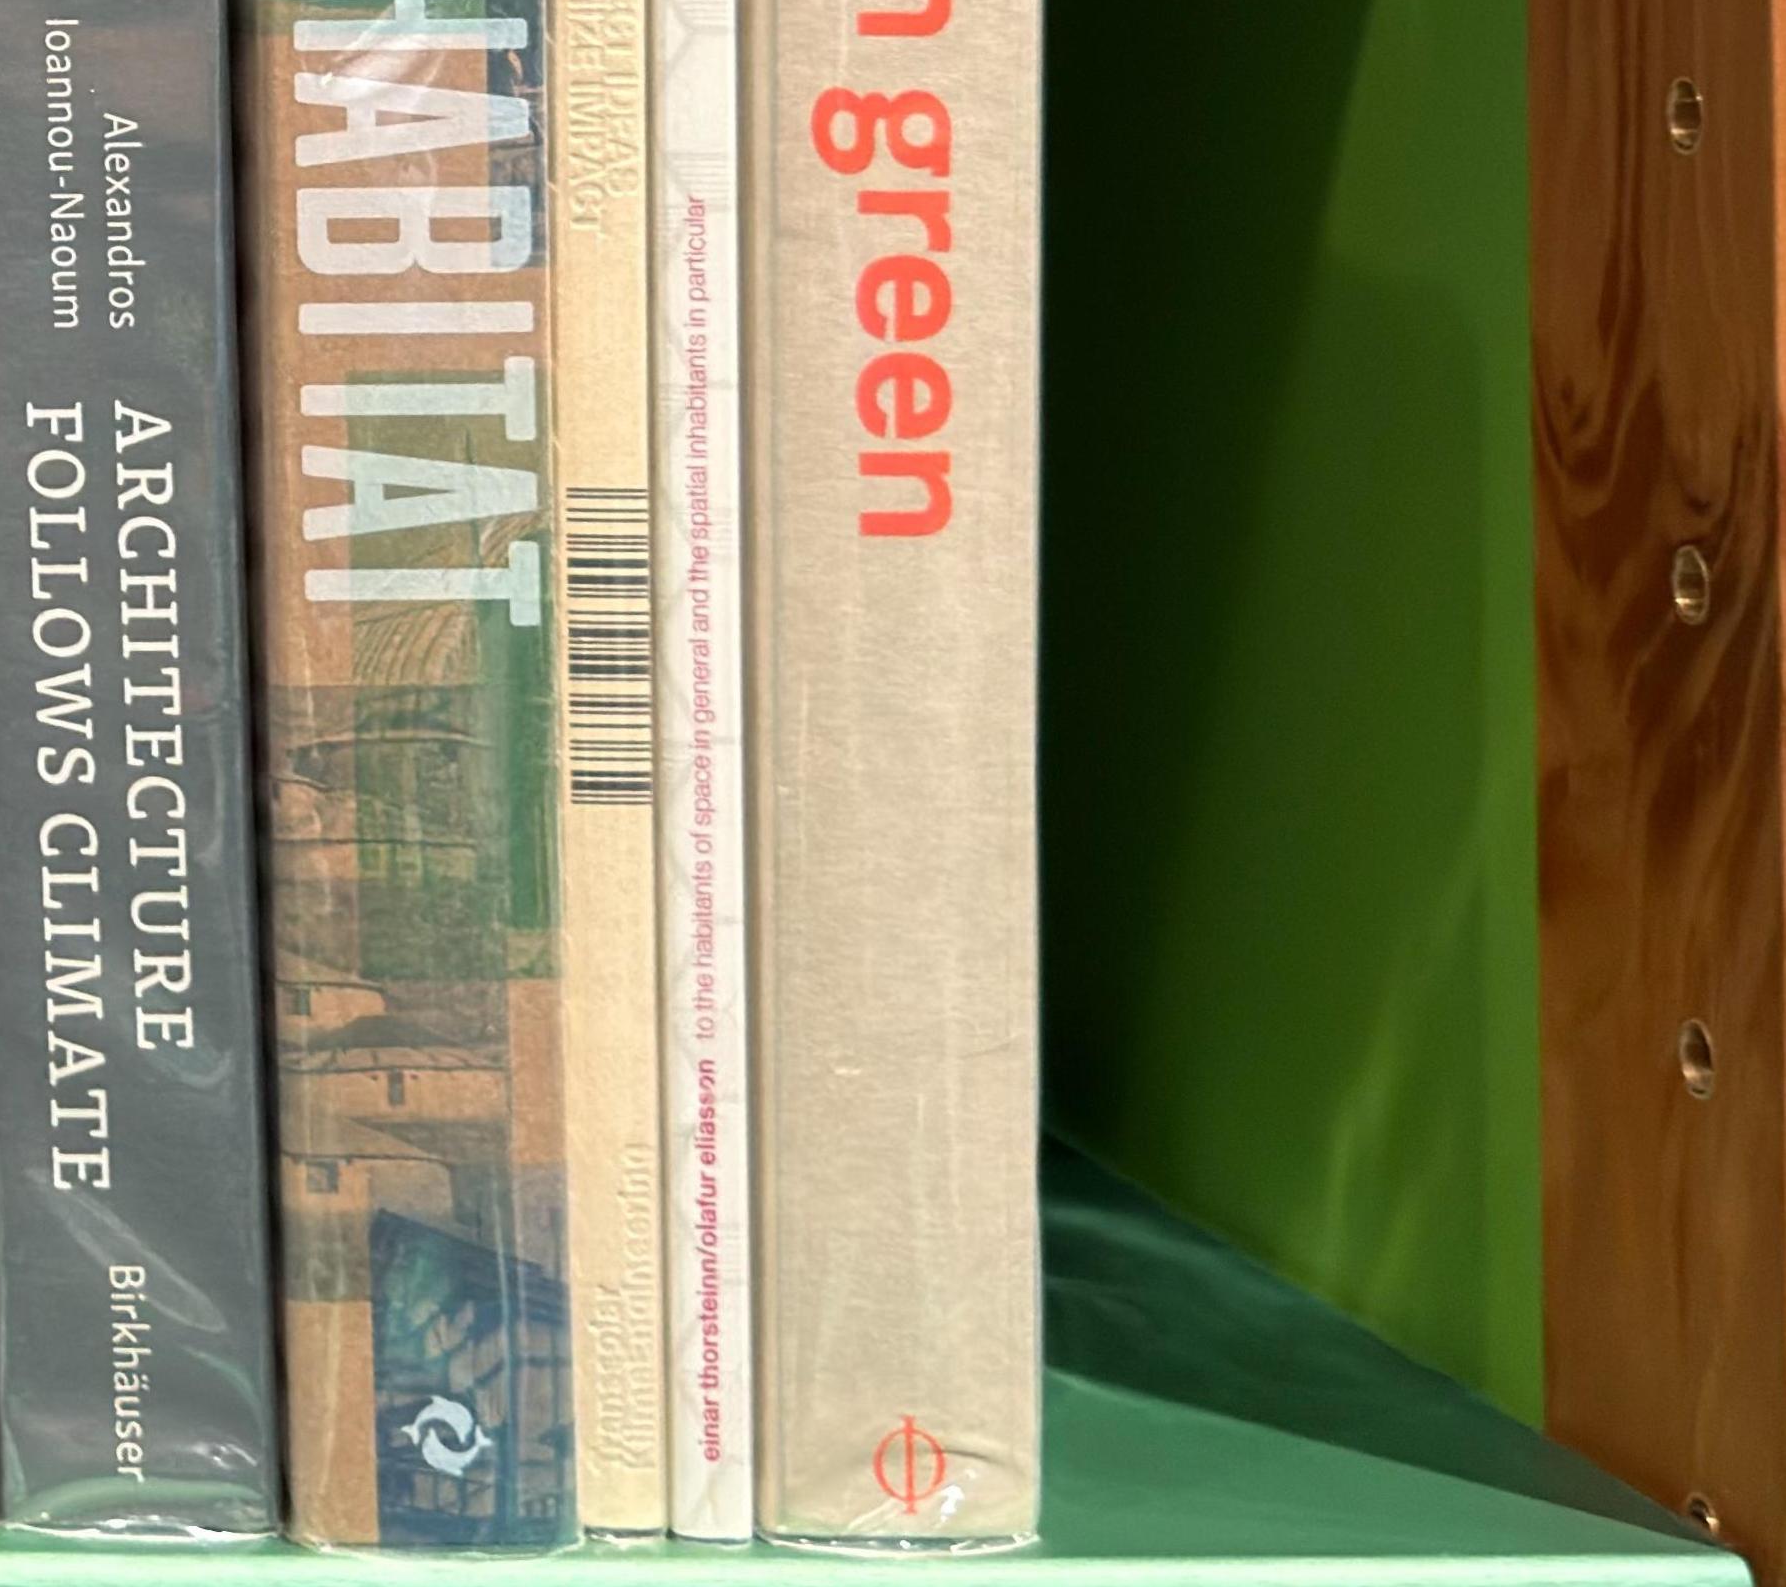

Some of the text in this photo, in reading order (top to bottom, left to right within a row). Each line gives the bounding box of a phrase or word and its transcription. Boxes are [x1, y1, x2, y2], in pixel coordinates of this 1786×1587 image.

[44, 17, 85, 330] Ioannou-Naoum
[102, 111, 146, 329] Alexandros
[567, 79, 608, 236] IMPACT
[810, 84, 955, 539] green
[25, 401, 111, 1191] FOLLOWS CLIMATE
[113, 398, 194, 1051] ARCHITECTURE
[685, 195, 721, 1463] einar thorsteinn/olafur eliasson to the habitants of space in general and the spatial inhabitants in particular
[108, 1264, 153, 1484] Birkhäuser
